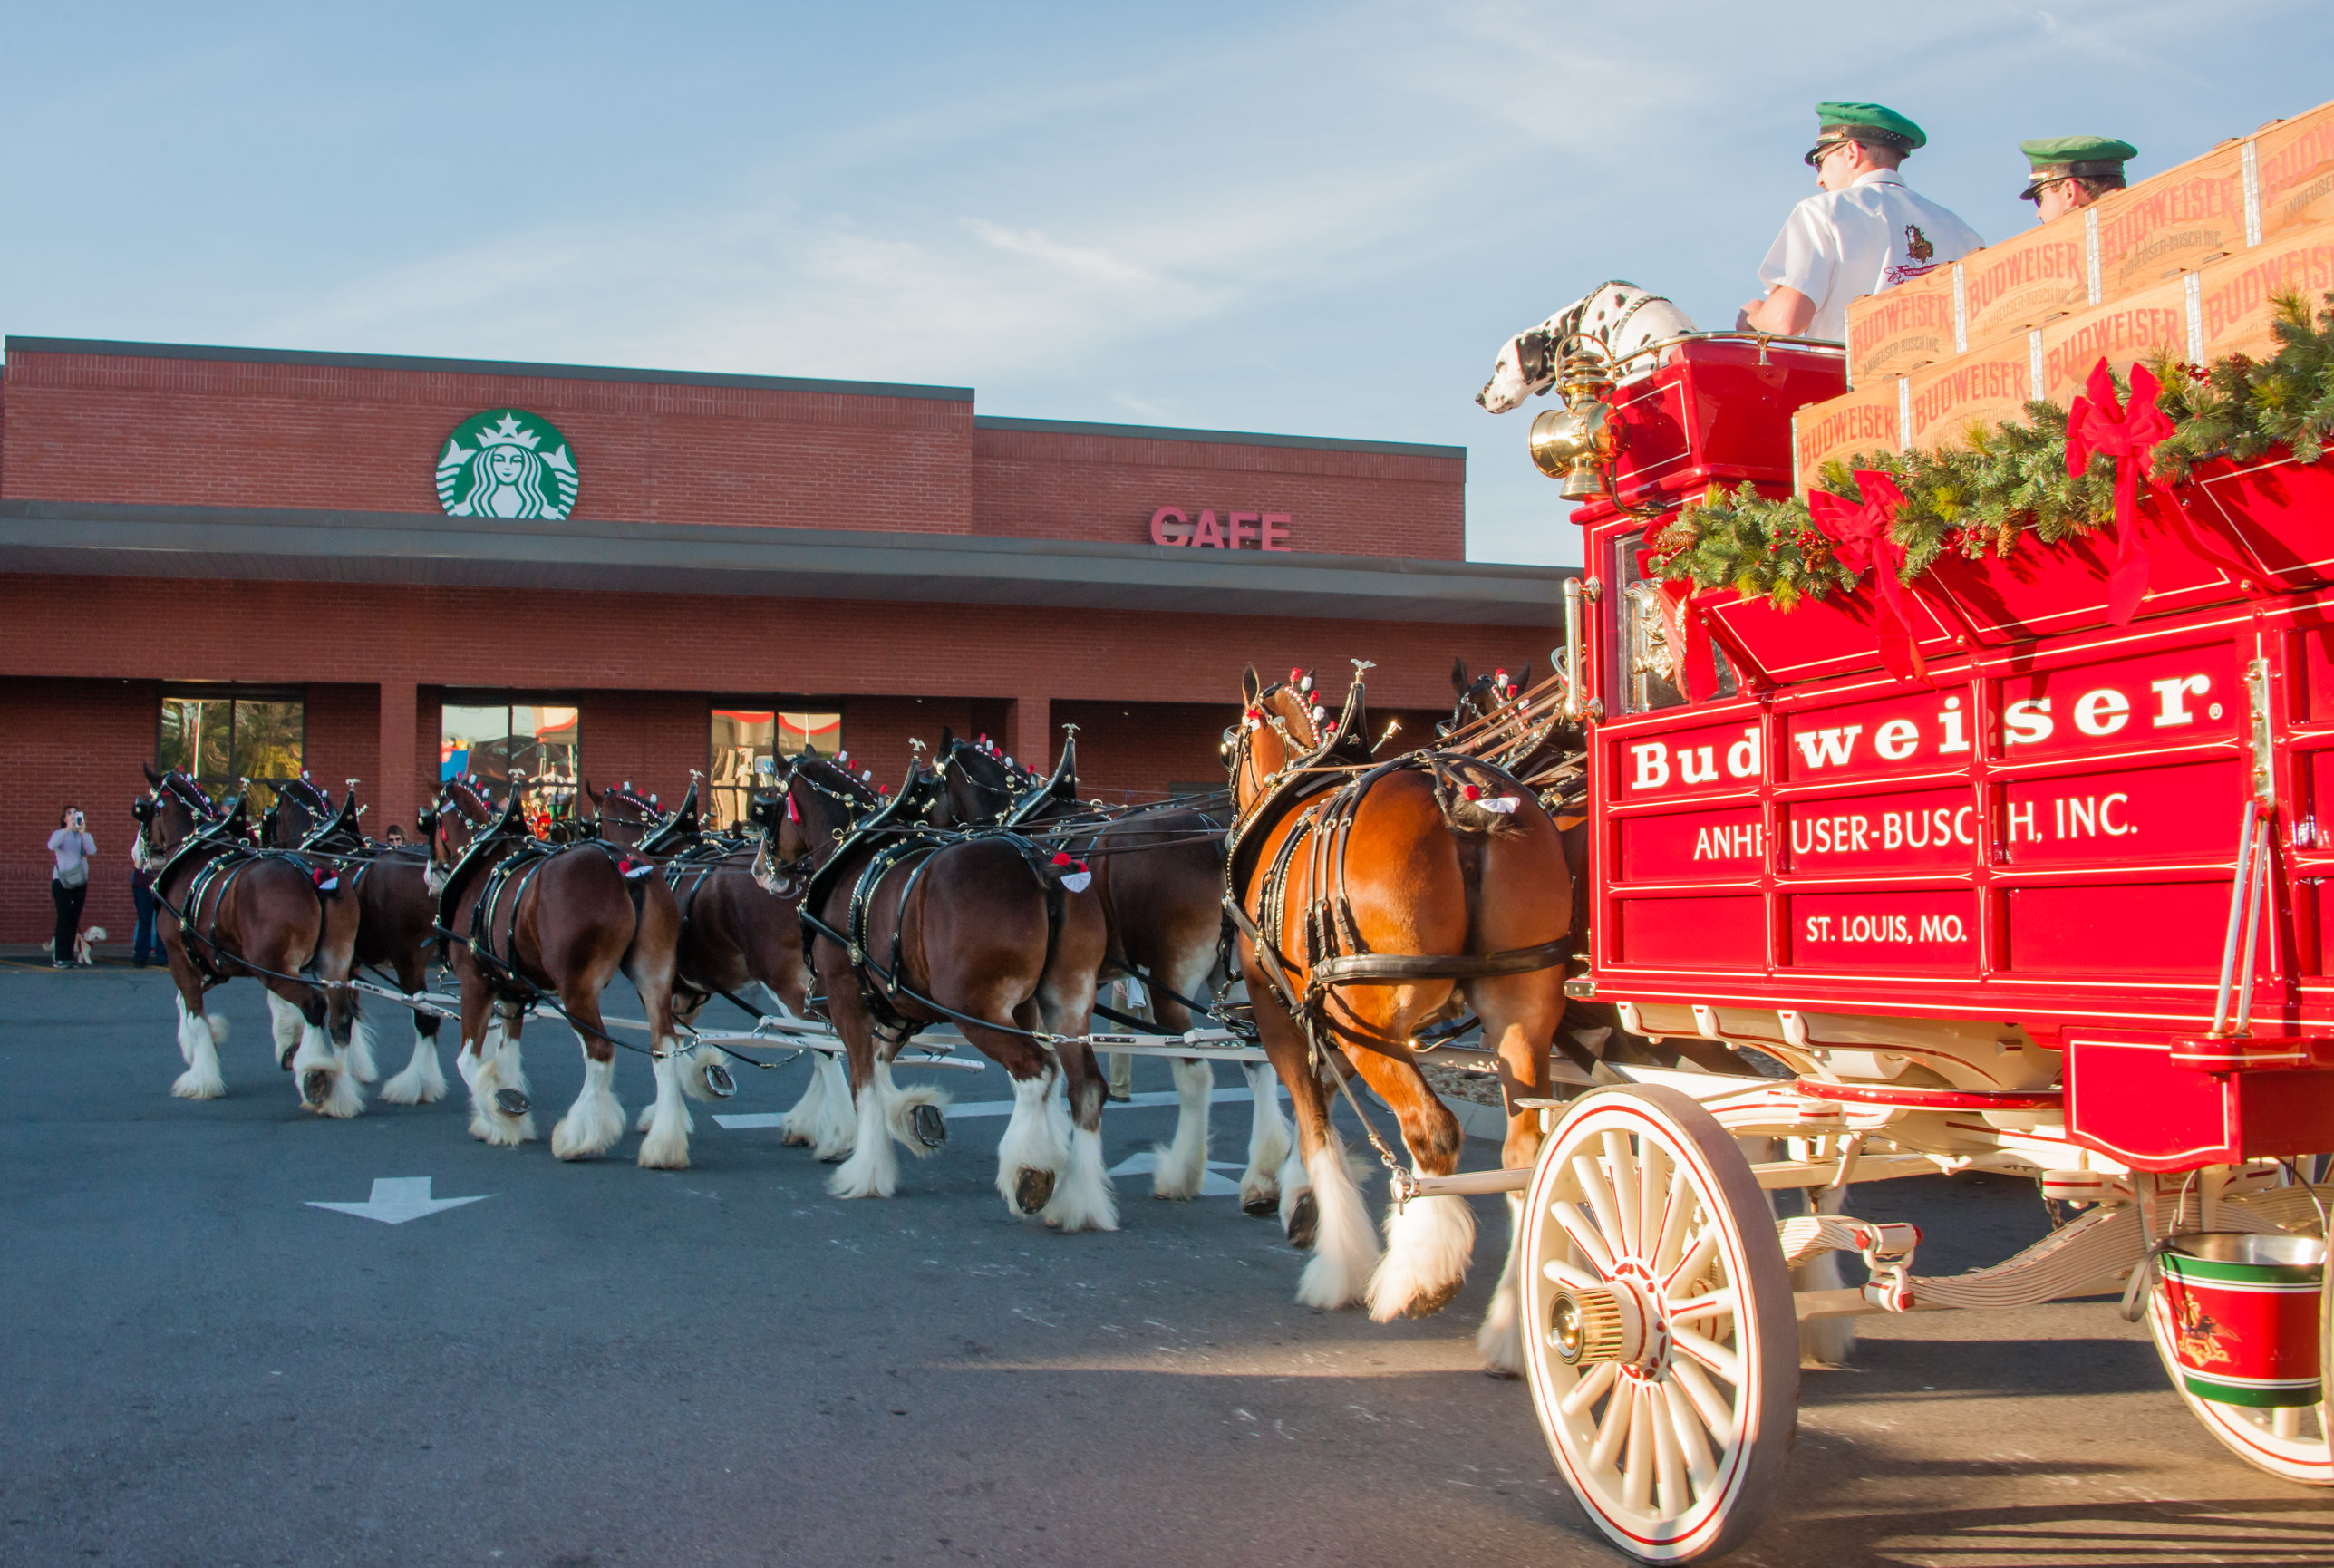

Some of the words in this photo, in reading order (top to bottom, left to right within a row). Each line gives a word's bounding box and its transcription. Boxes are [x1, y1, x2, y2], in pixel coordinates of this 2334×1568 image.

[2103, 179, 2242, 269] BUDWEISER
[1968, 242, 2086, 322] BUDWEISER
[2206, 246, 2334, 342] BUDWEIS
[1851, 295, 1953, 364] BUDWEISER
[2047, 308, 2184, 392] BUDWEISER
[1913, 361, 2029, 436] BUDWEISER
[1800, 404, 1900, 472] BUDWEISER
[1148, 506, 1292, 553] CAFE
[2055, 793, 2138, 839] INC.
[1806, 916, 1835, 942] ST.
[1842, 915, 1913, 944] LOUIS,
[1919, 915, 1968, 943] MO.
